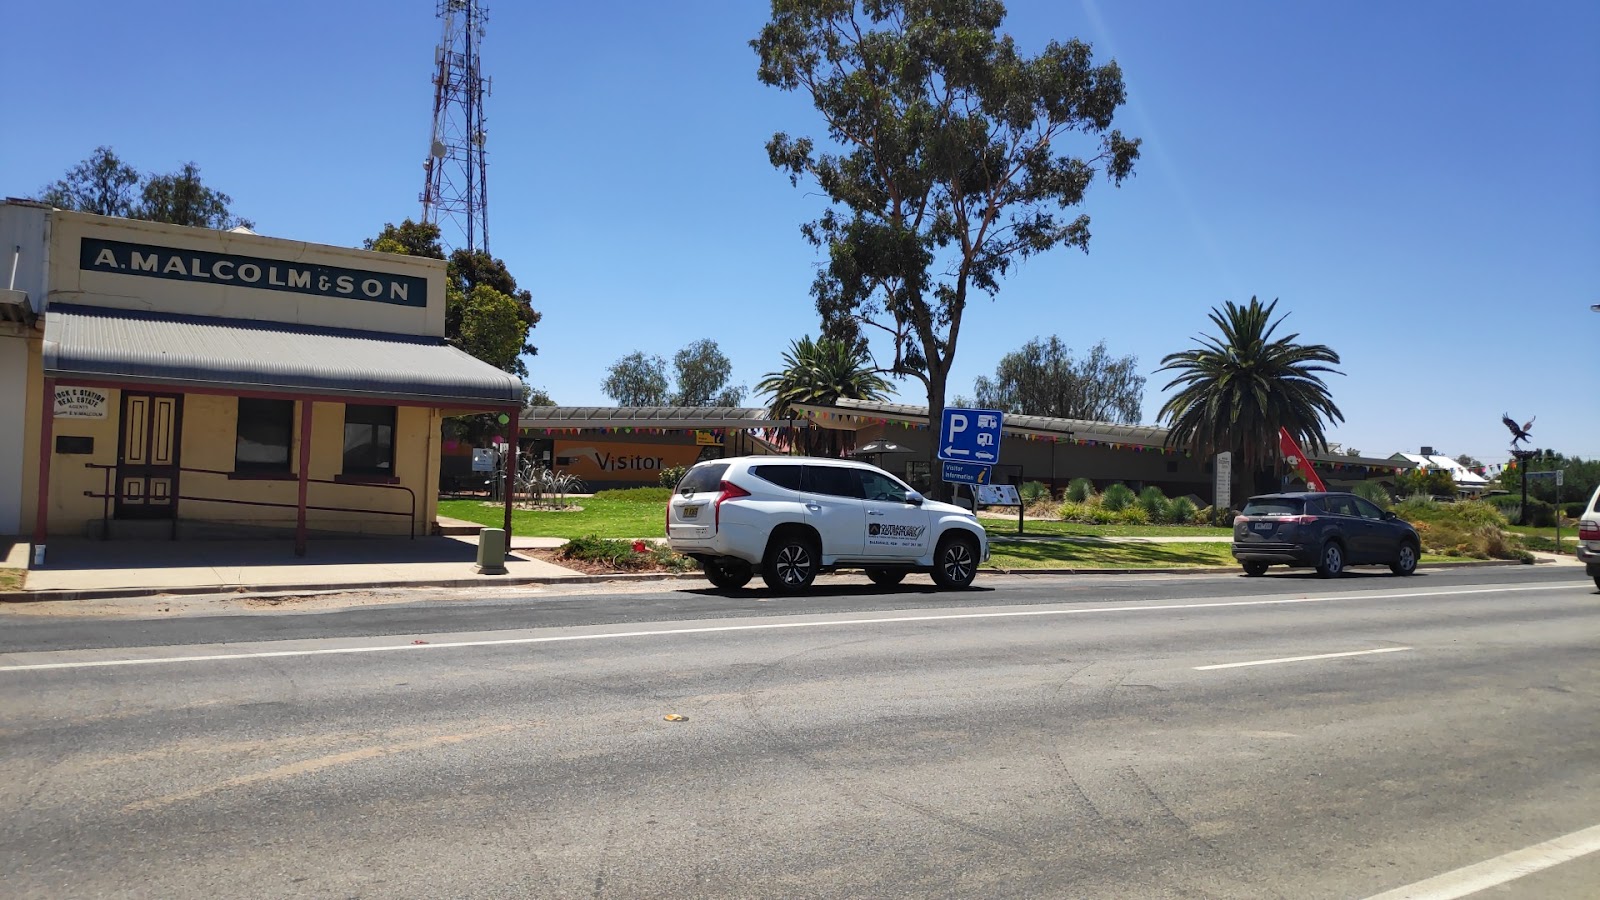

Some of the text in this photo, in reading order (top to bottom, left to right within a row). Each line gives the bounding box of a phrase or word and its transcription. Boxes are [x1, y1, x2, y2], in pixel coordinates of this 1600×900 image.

[336, 275, 409, 301] SON
[58, 397, 98, 408] REAL ESTATE
[80, 390, 106, 403] STATION
[948, 414, 968, 443] P
[595, 452, 664, 471] Visitor
